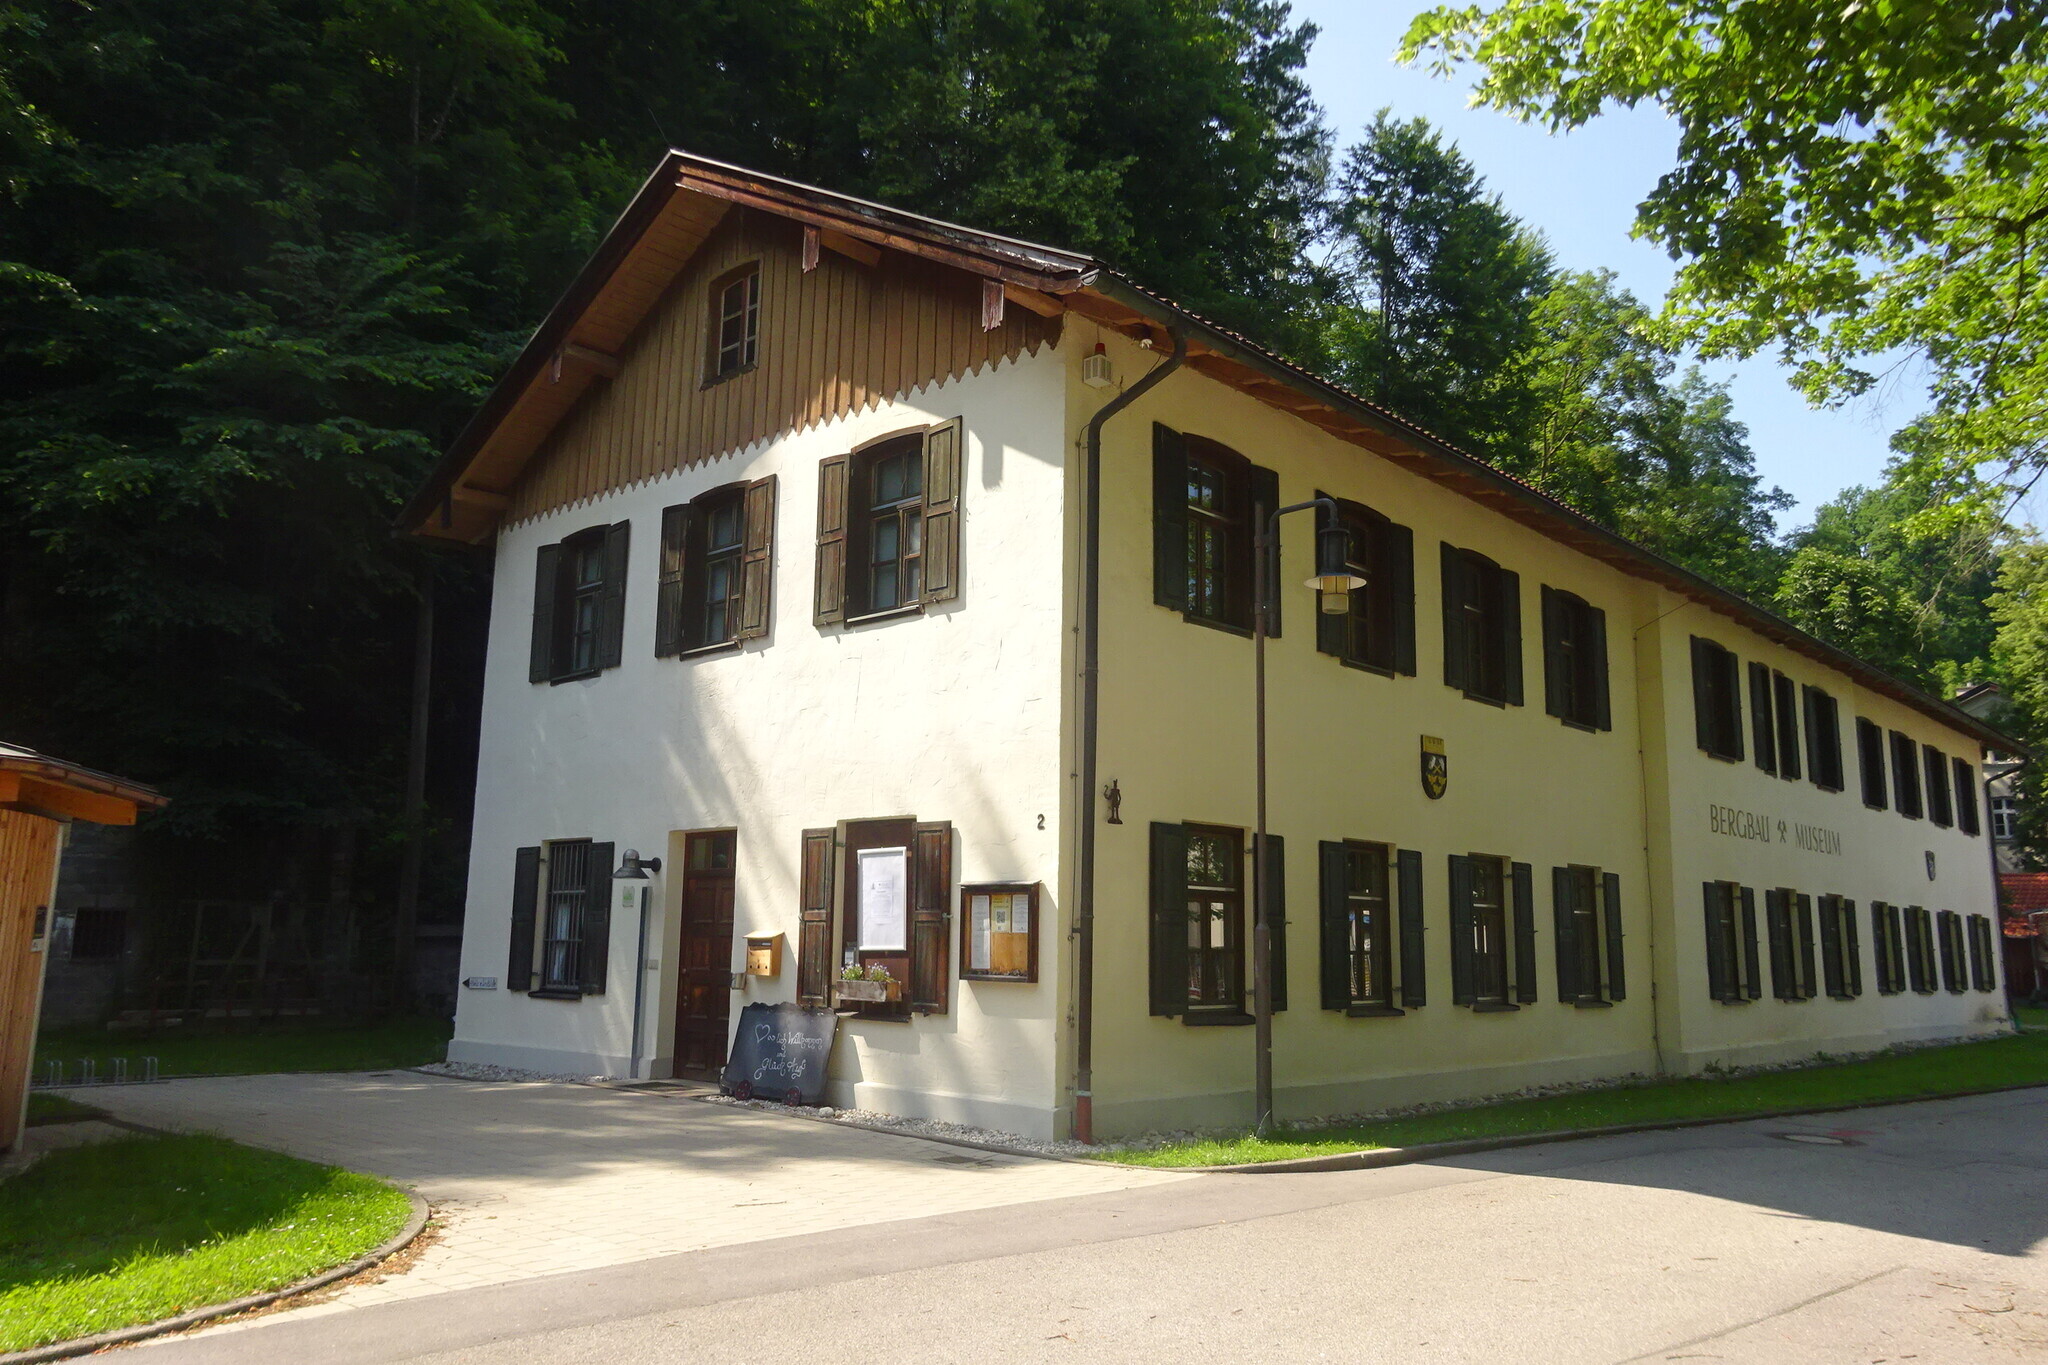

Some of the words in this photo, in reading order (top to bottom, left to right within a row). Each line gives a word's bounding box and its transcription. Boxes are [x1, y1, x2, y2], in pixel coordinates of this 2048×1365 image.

[1037, 813, 1046, 831] 2
[1709, 803, 1771, 844] BERGBAU
[1794, 822, 1842, 856] MUSEUM
[754, 1057, 786, 1080] Glück
